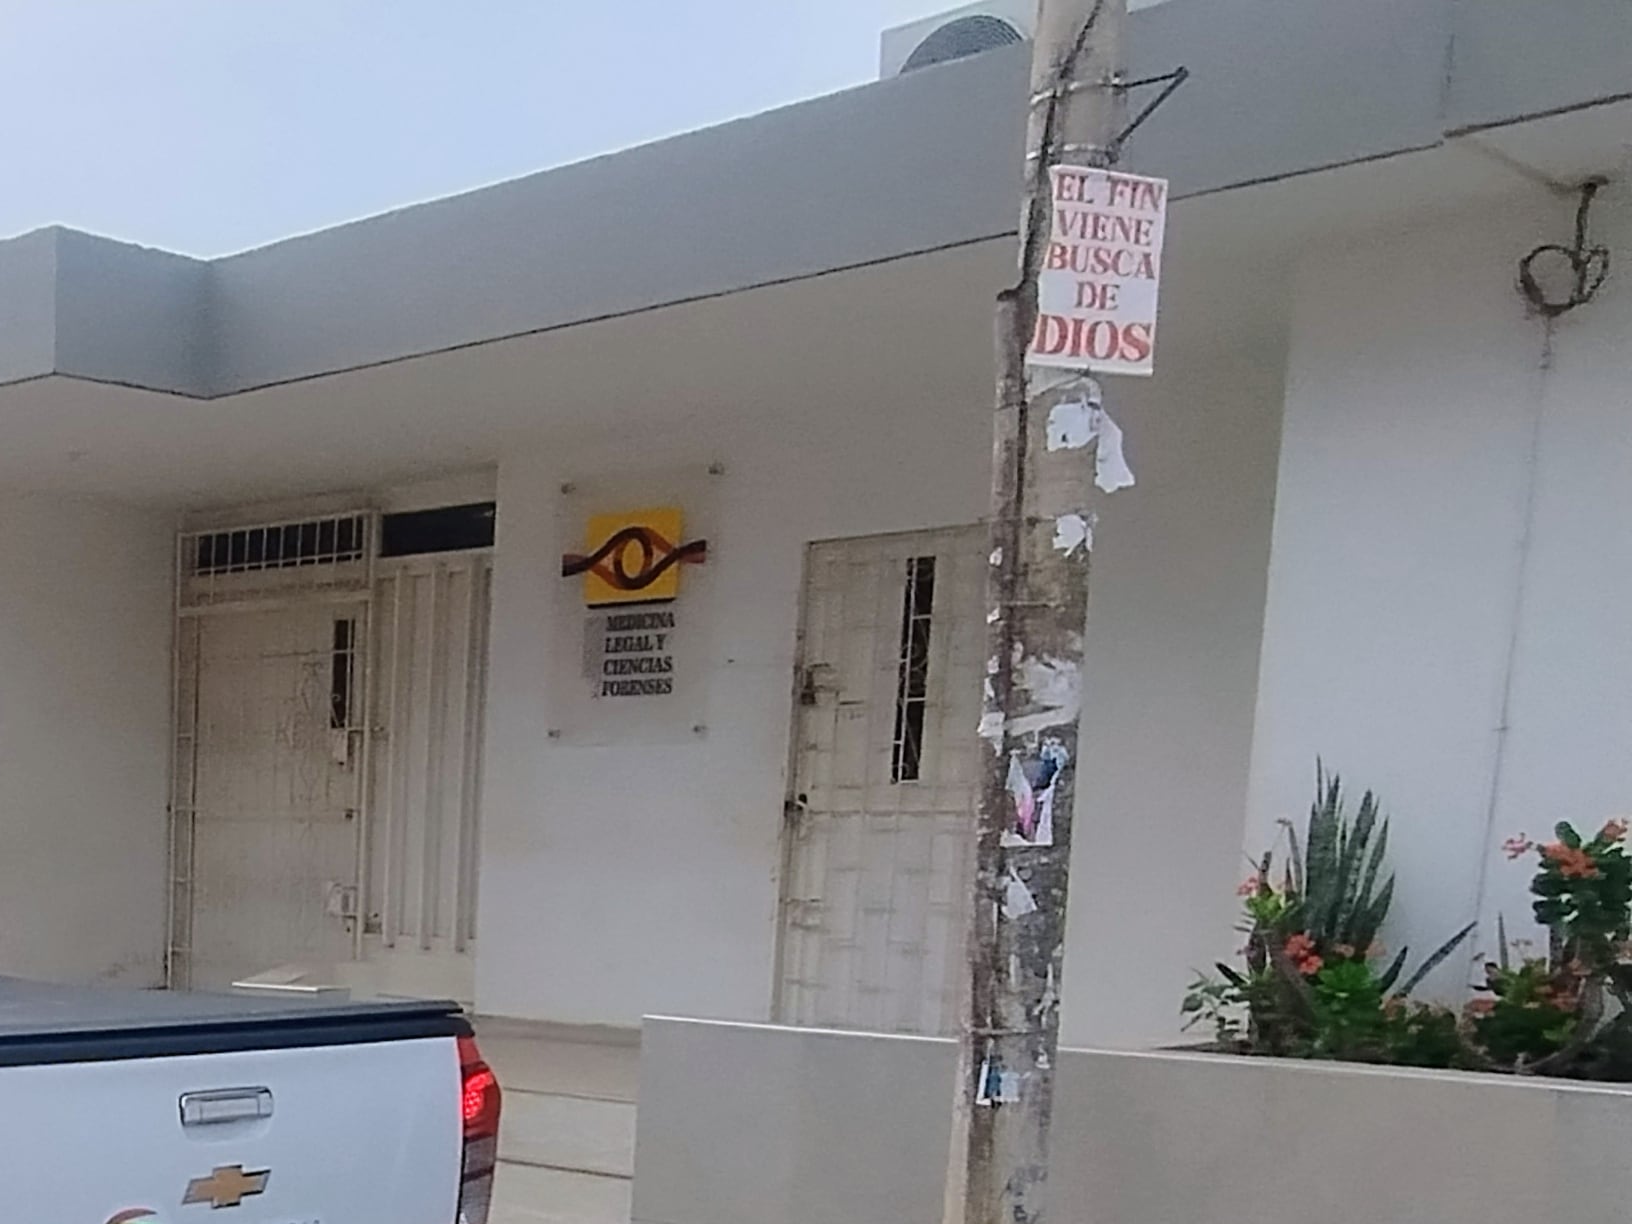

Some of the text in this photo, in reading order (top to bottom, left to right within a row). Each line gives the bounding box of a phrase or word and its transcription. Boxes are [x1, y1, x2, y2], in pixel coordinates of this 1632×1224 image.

[1055, 173, 1163, 210] EL FIN
[1057, 209, 1155, 247] VIENE
[1047, 243, 1156, 280] BUSCA
[1074, 281, 1120, 311] DE
[1033, 314, 1152, 362] DIOS
[606, 612, 675, 631] MEDICINA
[605, 634, 666, 653] LEGAL Y
[603, 656, 672, 675] CIENCIAS
[601, 678, 672, 696] FORENSES
